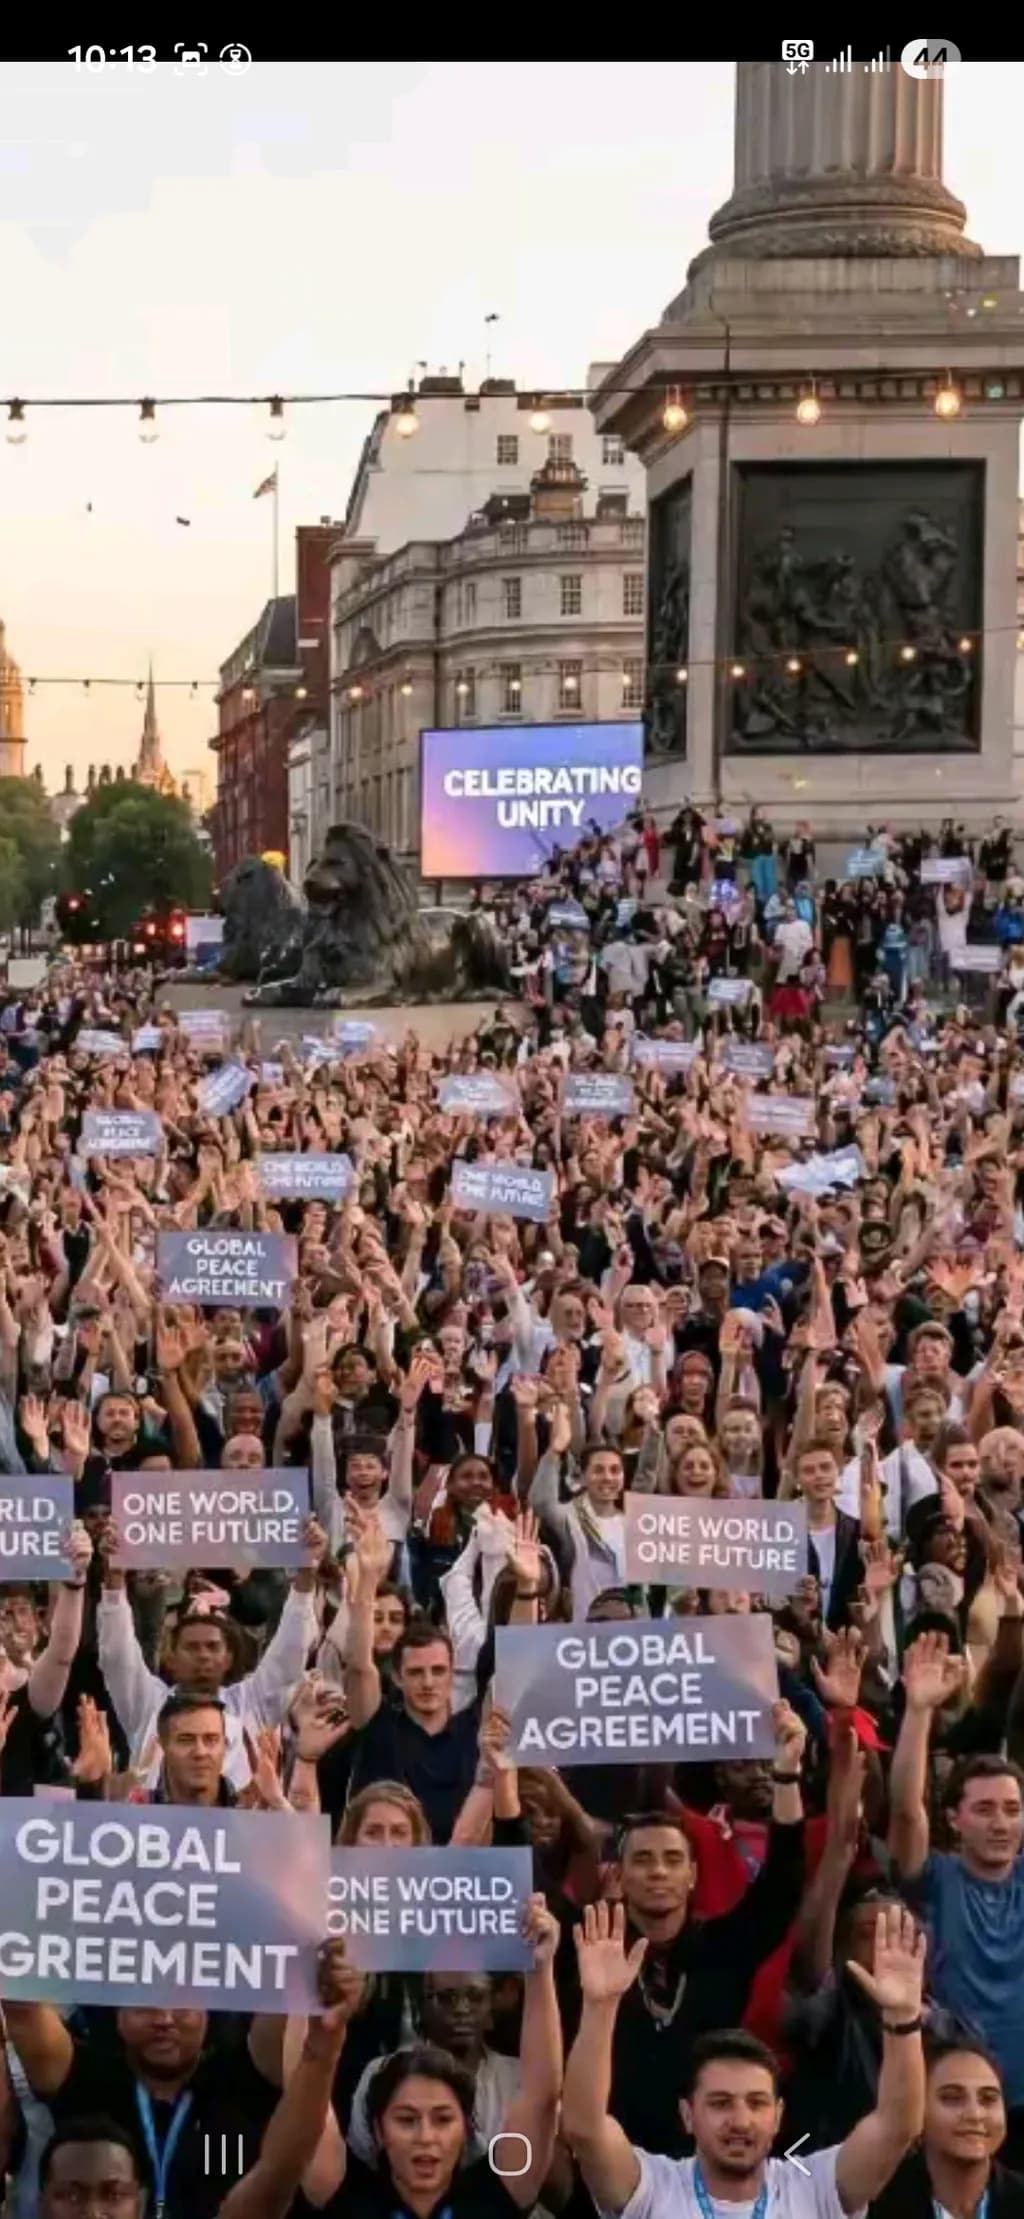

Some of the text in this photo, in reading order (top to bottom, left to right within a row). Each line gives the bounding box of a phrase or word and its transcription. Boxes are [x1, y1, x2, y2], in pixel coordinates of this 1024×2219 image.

[443, 765, 642, 797] CELEBRATING
[498, 799, 584, 828] UNITY
[187, 1239, 267, 1257] GLOBAL
[196, 1259, 259, 1277] PEACE
[0, 1499, 63, 1525] RLD,
[122, 1490, 300, 1516] ONE WORLD,
[124, 1519, 298, 1545] ONE FUTURE
[637, 1513, 799, 1545] ONE WORLD,
[637, 1541, 796, 1572] ONE FUTURE
[556, 1633, 716, 1670] GLOBAL
[574, 1672, 703, 1709] PEACE
[517, 1710, 762, 1752] AGREEMENT
[16, 1818, 241, 1874] GLOBAL
[36, 1877, 218, 1928] PEACE
[327, 1876, 518, 1905] ONE WORLD,
[327, 1908, 518, 1936] ONE FUTURE
[0, 1932, 298, 1990] GREEMENT
